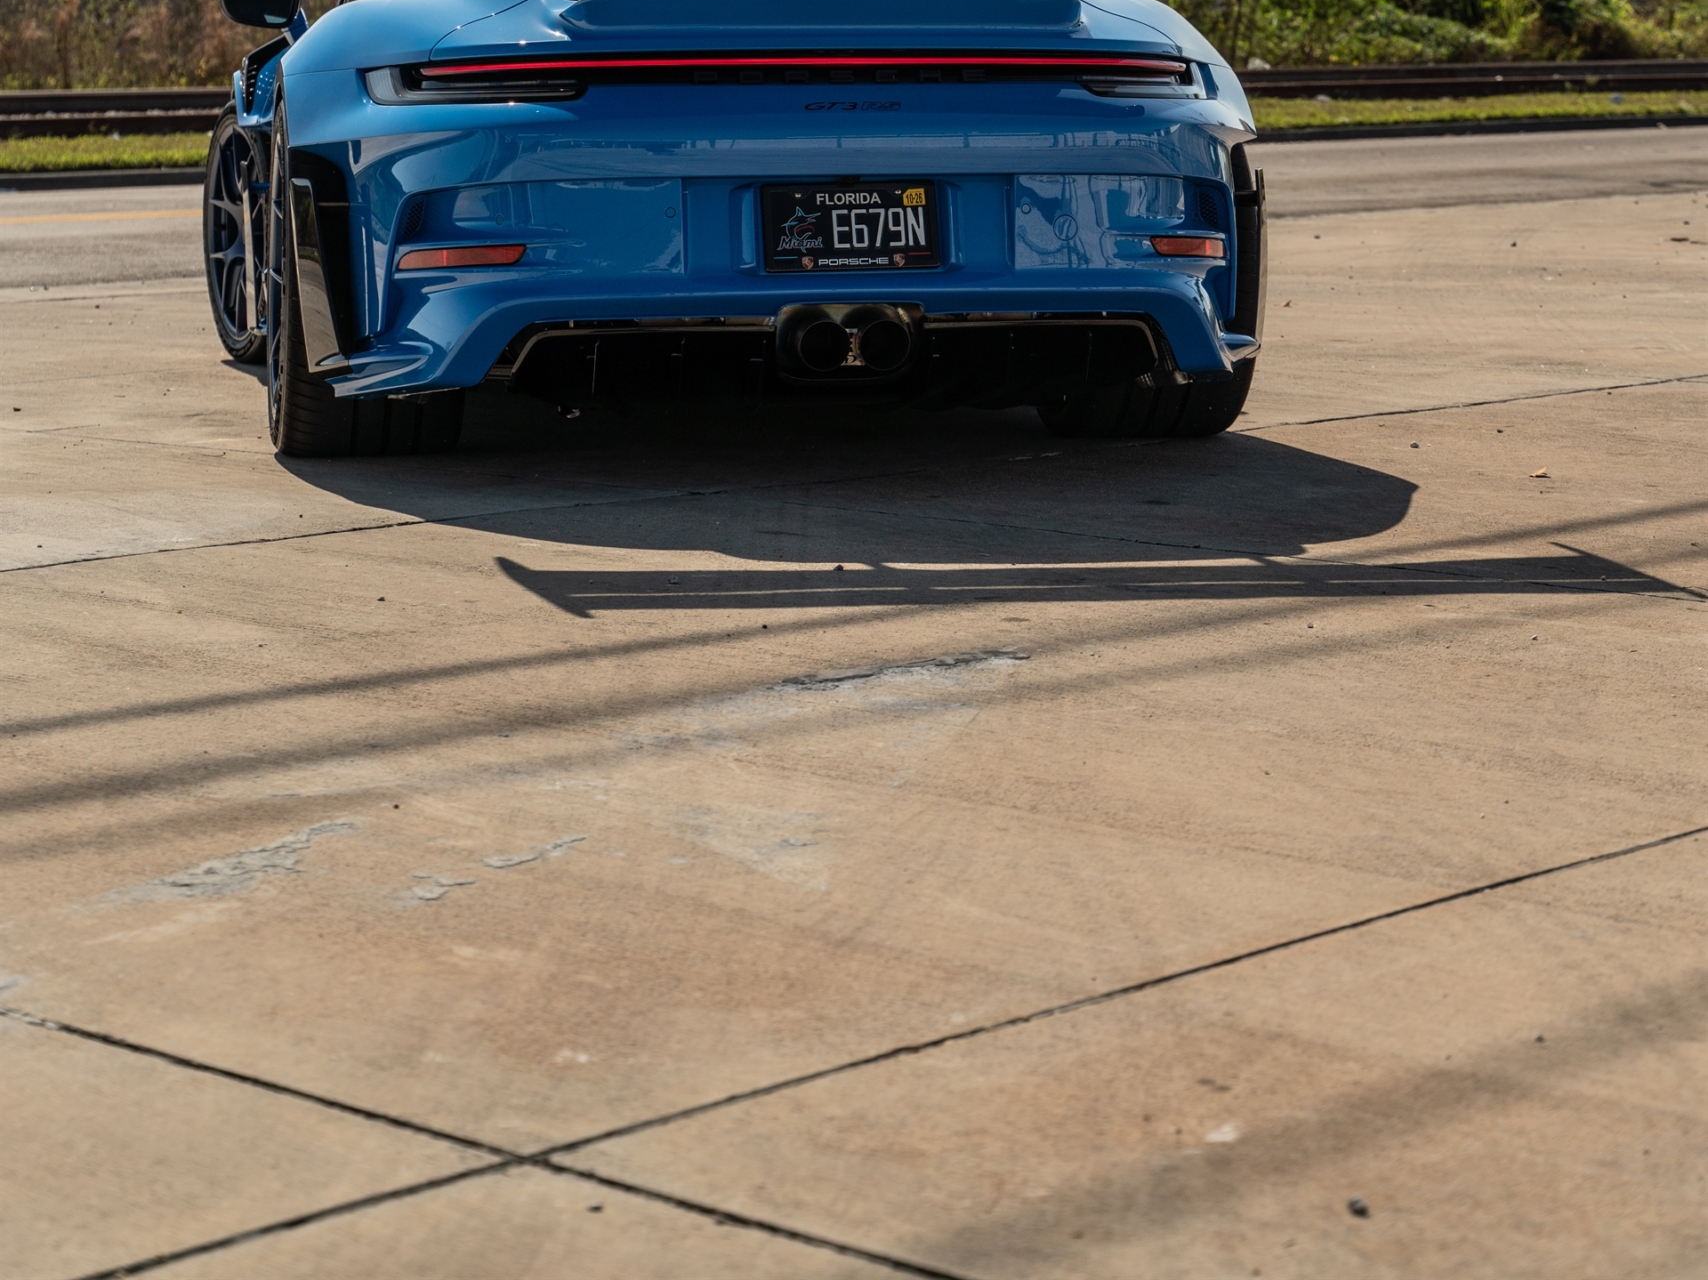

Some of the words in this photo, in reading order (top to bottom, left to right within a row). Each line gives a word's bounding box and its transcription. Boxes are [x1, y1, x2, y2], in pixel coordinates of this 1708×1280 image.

[693, 69, 987, 84] PORSCHE
[804, 101, 859, 111] GT3
[861, 101, 902, 111] RS
[816, 192, 881, 205] FLORIDA
[905, 192, 923, 205] 10-26
[831, 207, 926, 249] E679N
[777, 235, 823, 251] Miami
[818, 257, 889, 266] PORSCHE
